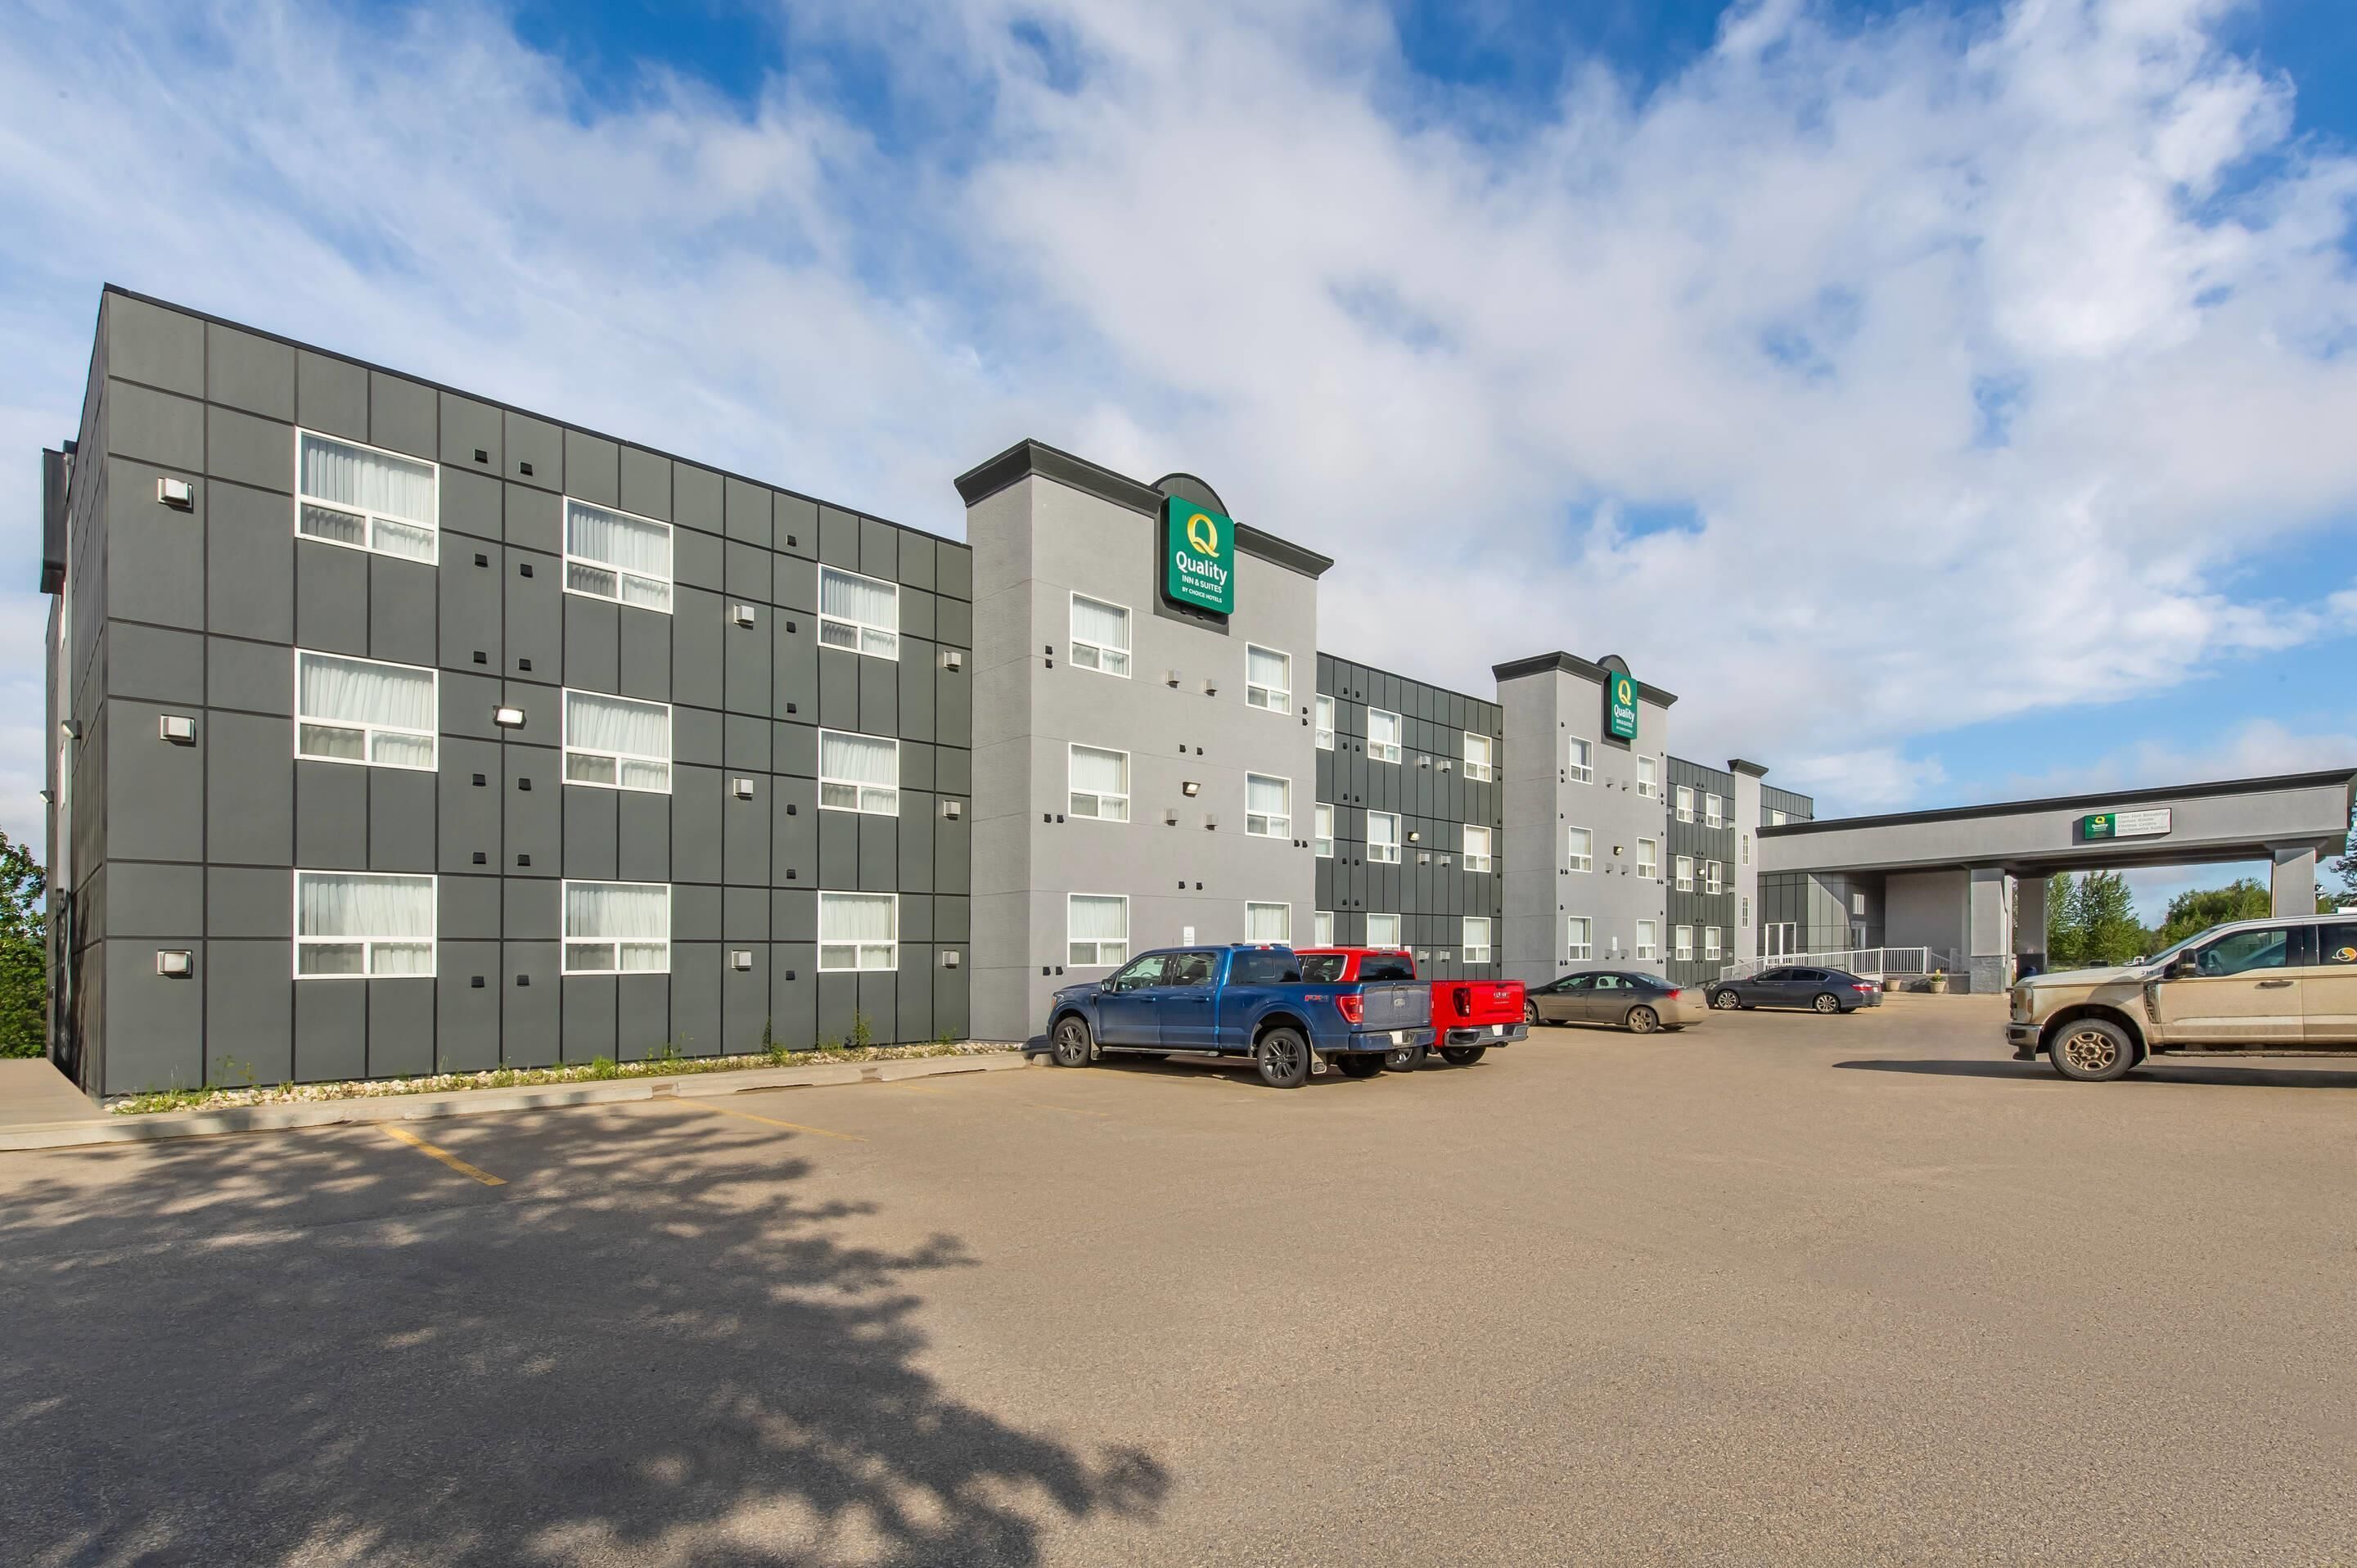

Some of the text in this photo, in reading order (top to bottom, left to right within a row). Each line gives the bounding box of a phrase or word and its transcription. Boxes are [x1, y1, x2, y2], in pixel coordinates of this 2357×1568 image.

[1188, 513, 1219, 558] Q
[1176, 551, 1228, 585] Quality
[1182, 574, 1223, 594] INN & SUITES
[1188, 588, 1206, 598] CHOICE
[1206, 593, 1223, 603] HOTELS
[1618, 679, 1632, 705] Q
[1614, 704, 1635, 723] Quality
